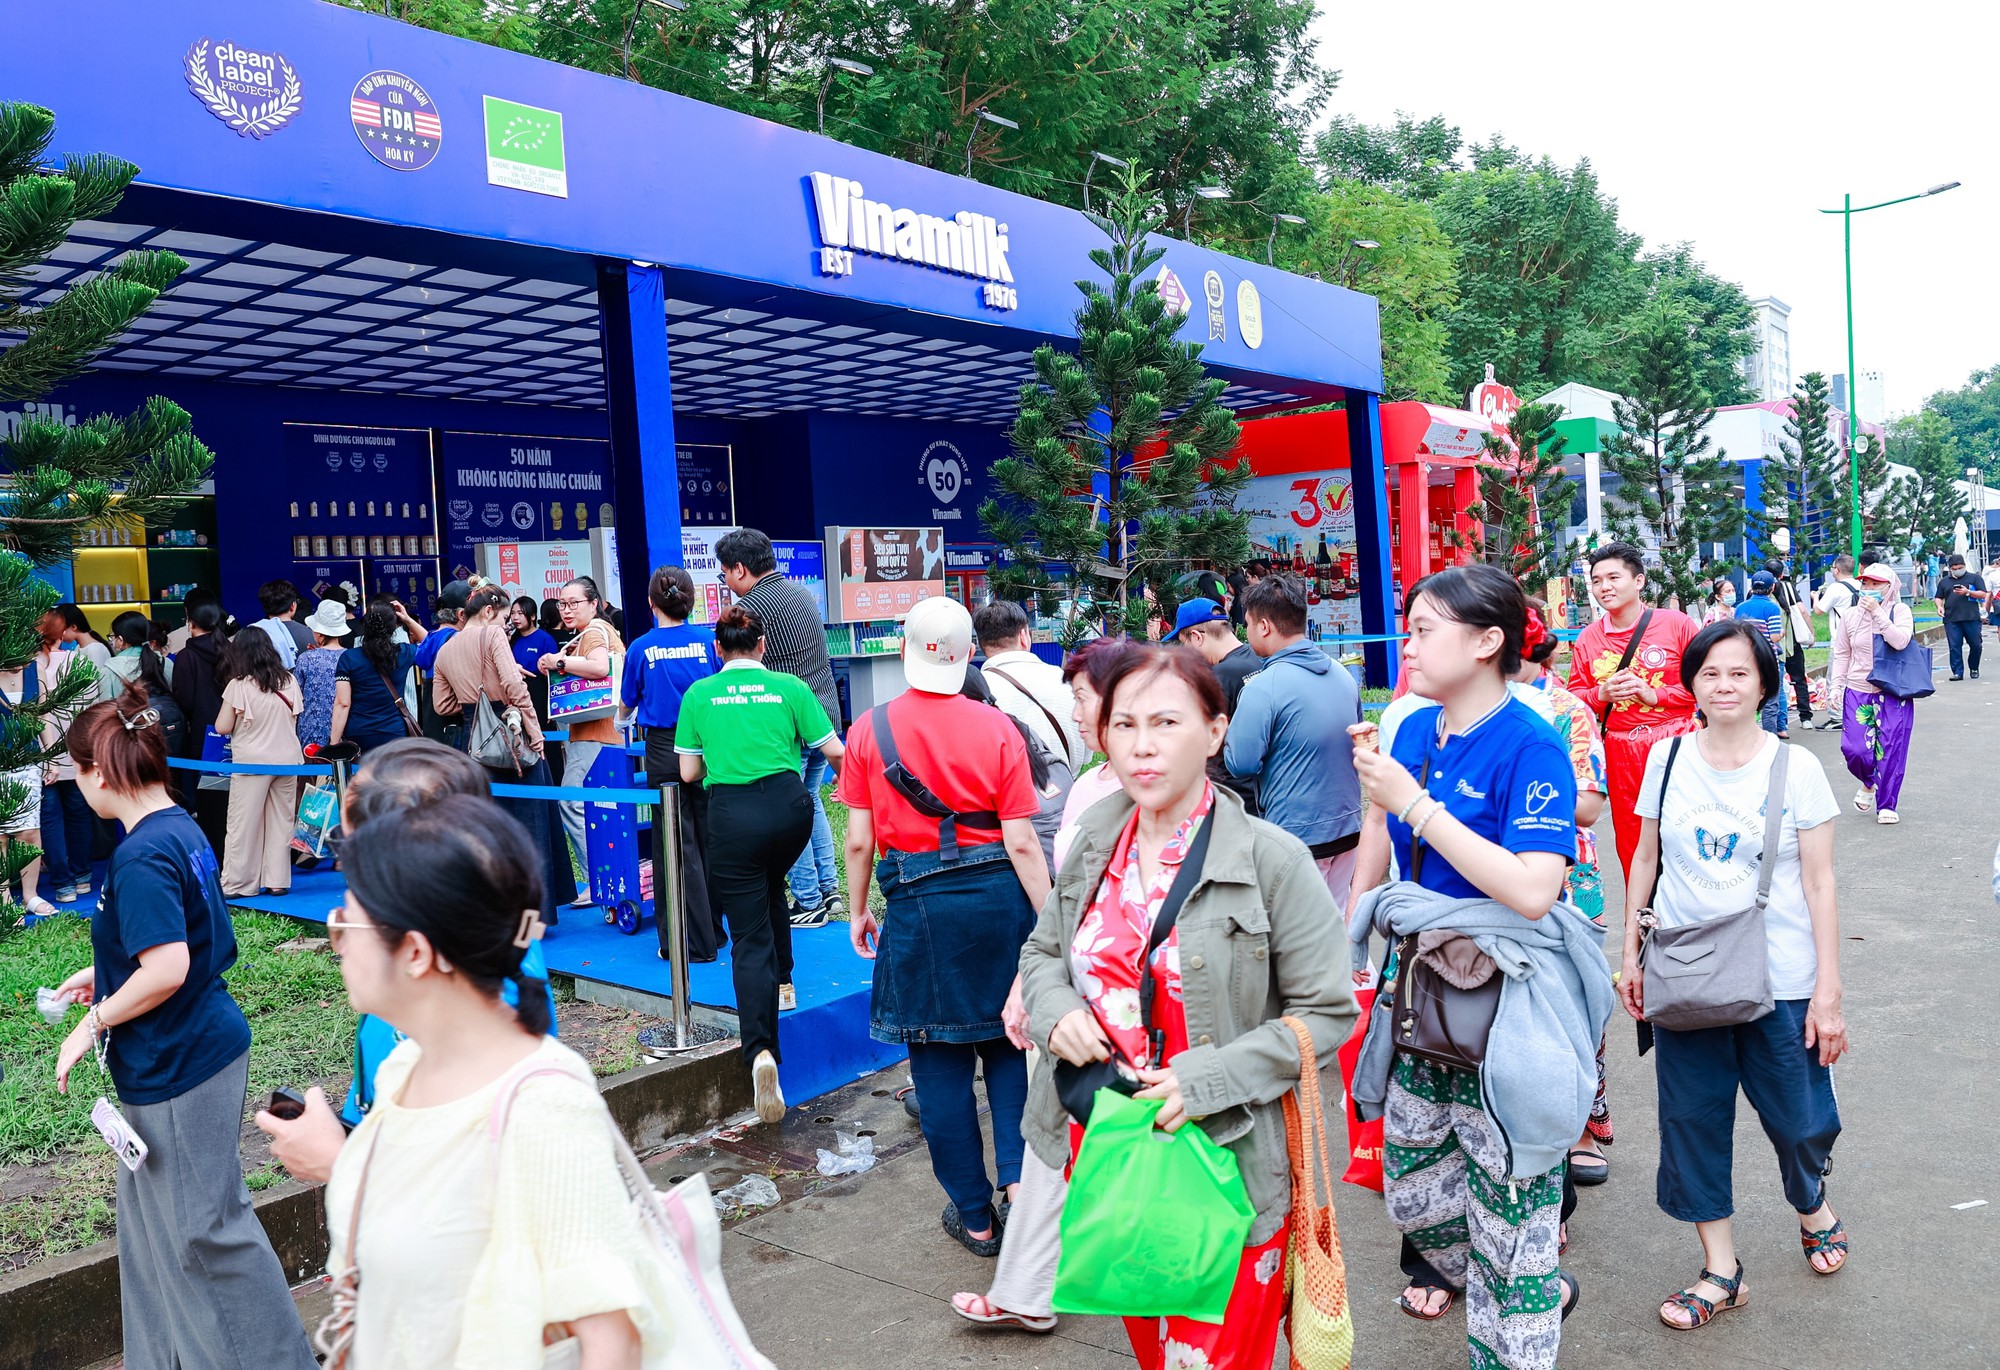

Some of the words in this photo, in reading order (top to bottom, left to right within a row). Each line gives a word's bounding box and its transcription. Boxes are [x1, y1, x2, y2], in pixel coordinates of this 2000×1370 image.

[214, 43, 274, 70] clean
[218, 60, 273, 88] label
[383, 107, 414, 132] FDA
[385, 147, 402, 161] HOA
[497, 176, 520, 184] VIETNAM
[539, 170, 562, 180] ORGANIC
[810, 171, 1014, 282] Vinamilk
[821, 247, 853, 276] EST
[983, 283, 1018, 310] 1976
[352, 436, 364, 445] CHO
[510, 448, 525, 465] 50
[526, 447, 550, 466] NĂM
[457, 468, 497, 487] KHÔNG
[538, 471, 566, 489] NÂNG
[935, 472, 955, 491] 50
[932, 508, 962, 520] Vinamilk
[692, 559, 706, 569] HOA
[946, 551, 984, 565] Vinamilk
[316, 567, 330, 577] KEM
[644, 643, 706, 662] Vinamilk
[752, 693, 782, 703] THỐNG
[1513, 817, 1538, 826] VICTORIA
[1675, 811, 1691, 828] SET
[1691, 803, 1741, 817] YOURSELF
[1741, 816, 1761, 838] FREE
[1674, 851, 1692, 877] FREE
[1744, 860, 1758, 880] SET
[1692, 874, 1745, 890] YOURSELF
